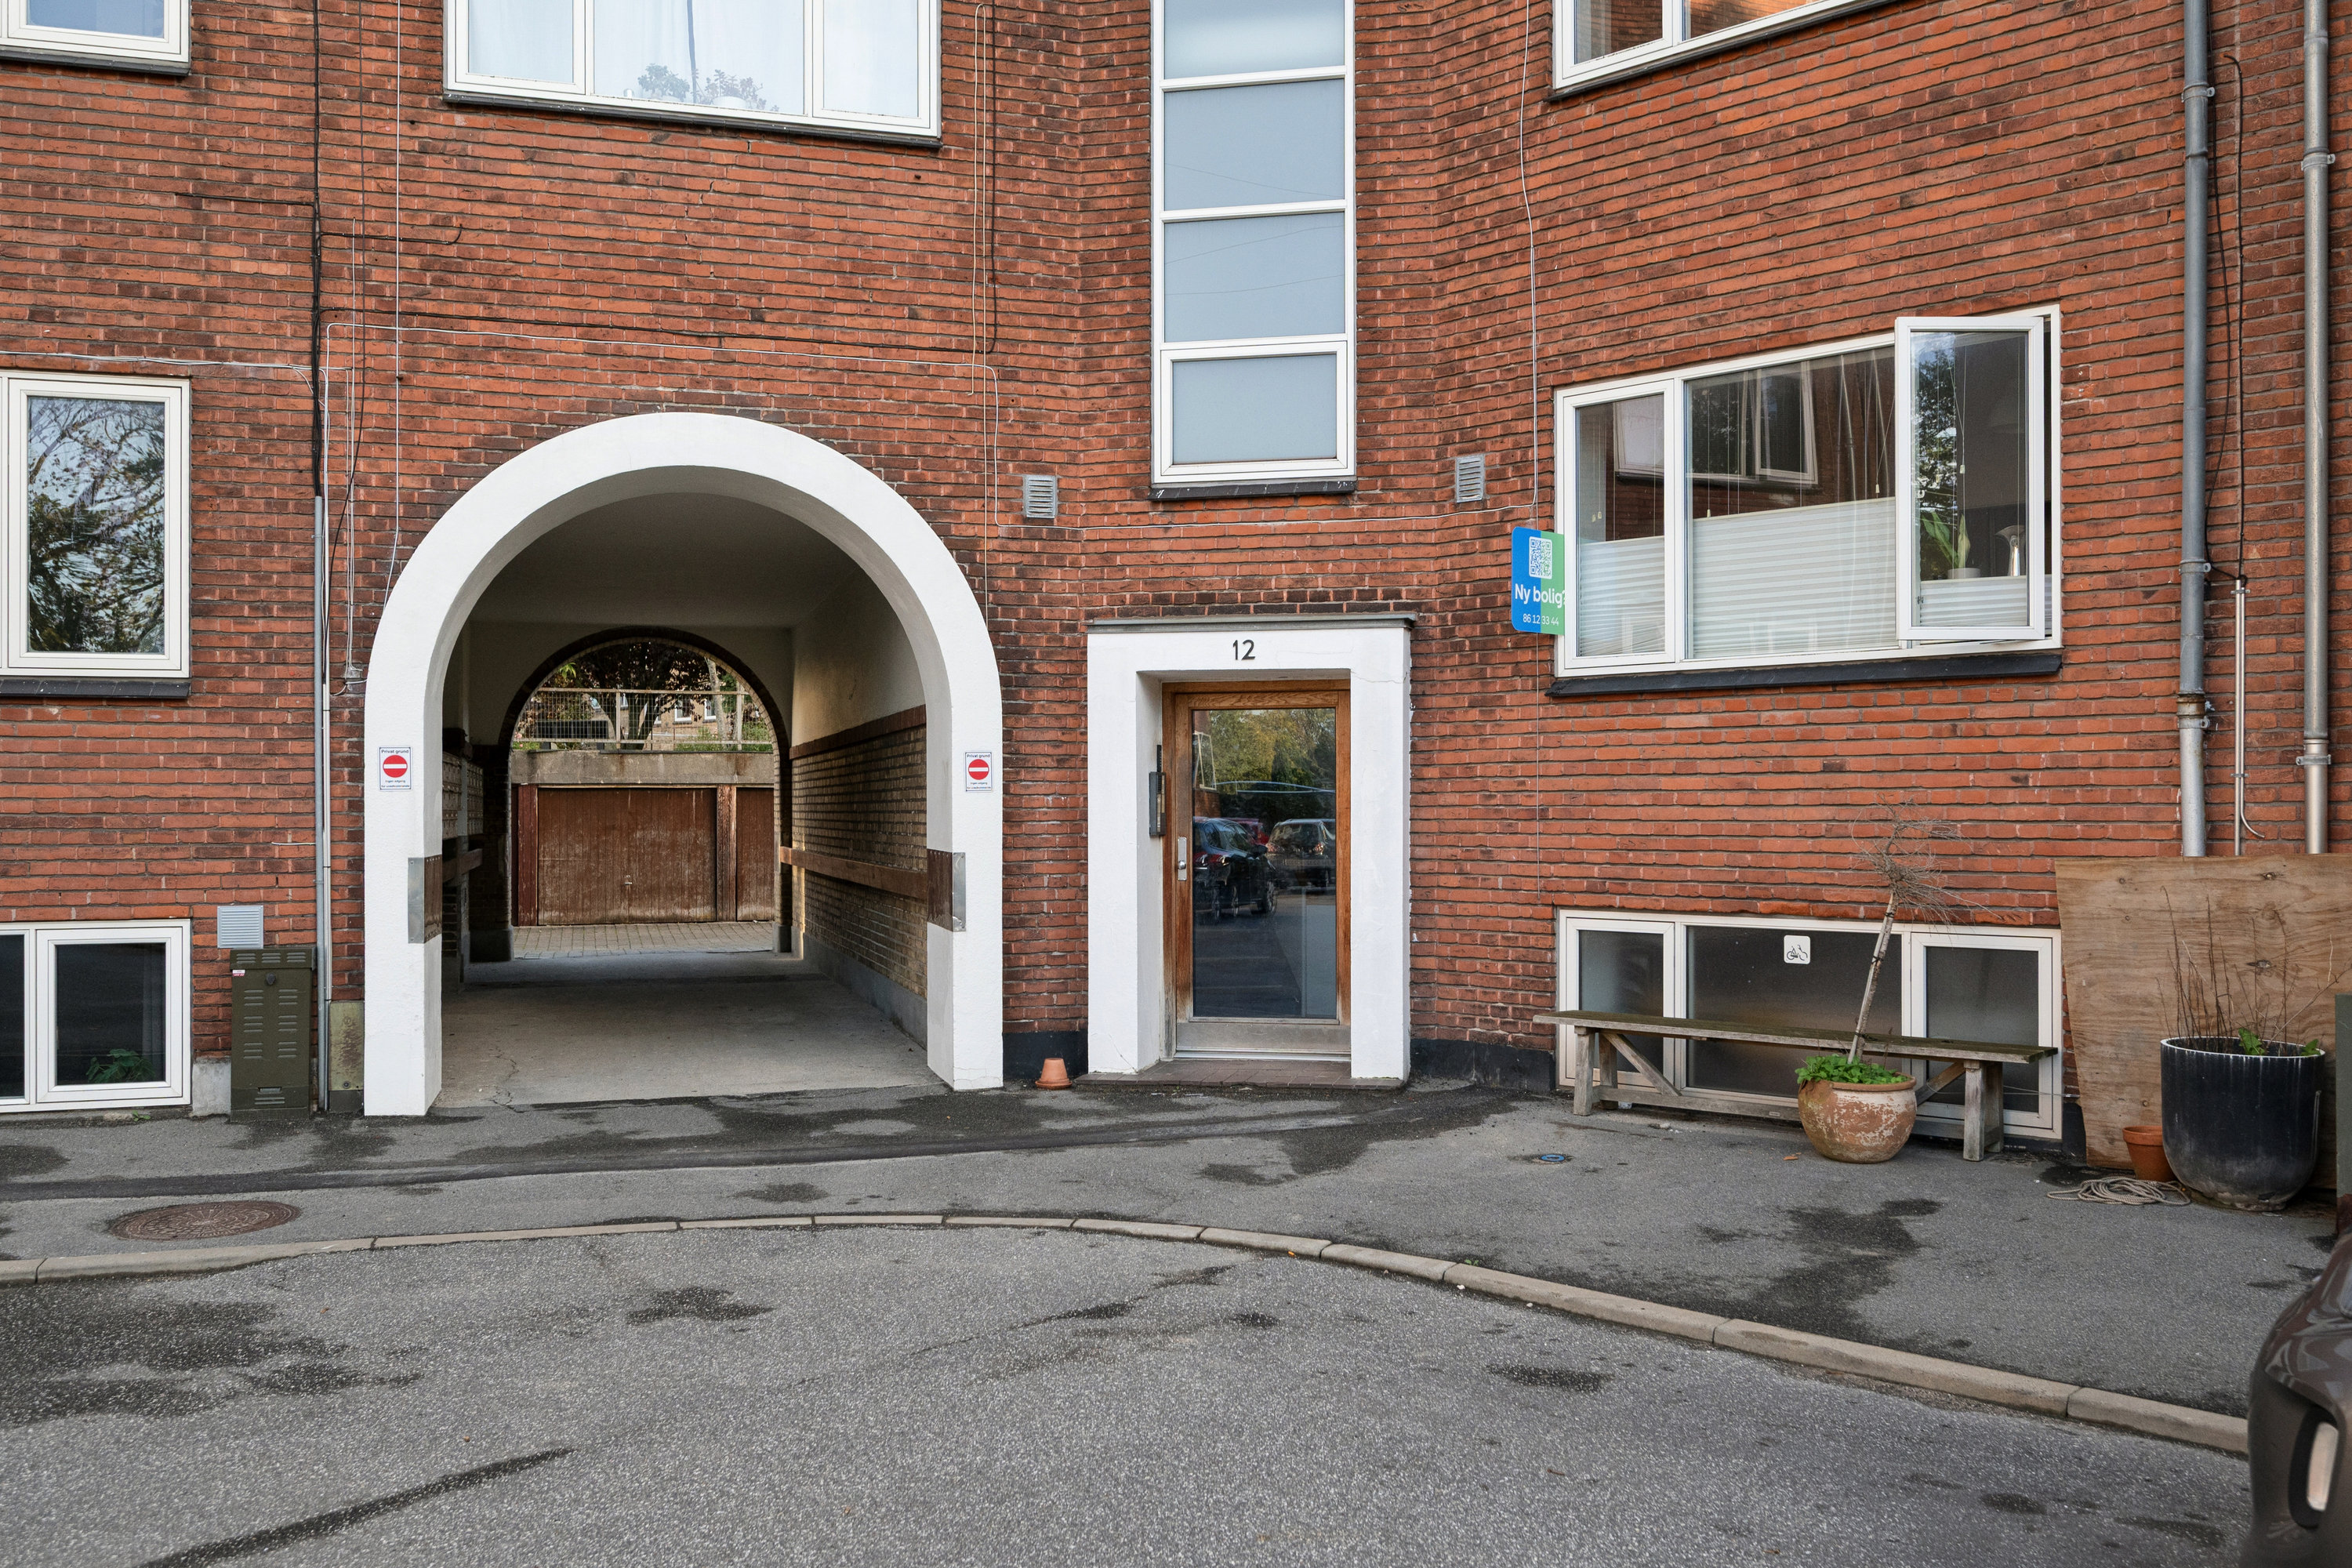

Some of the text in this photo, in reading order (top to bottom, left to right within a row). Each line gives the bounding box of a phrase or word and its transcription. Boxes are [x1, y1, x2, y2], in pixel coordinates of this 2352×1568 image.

[1515, 583, 1531, 604] Ny
[1523, 613, 1559, 626] 86 12 33 44
[1232, 639, 1256, 660] 12
